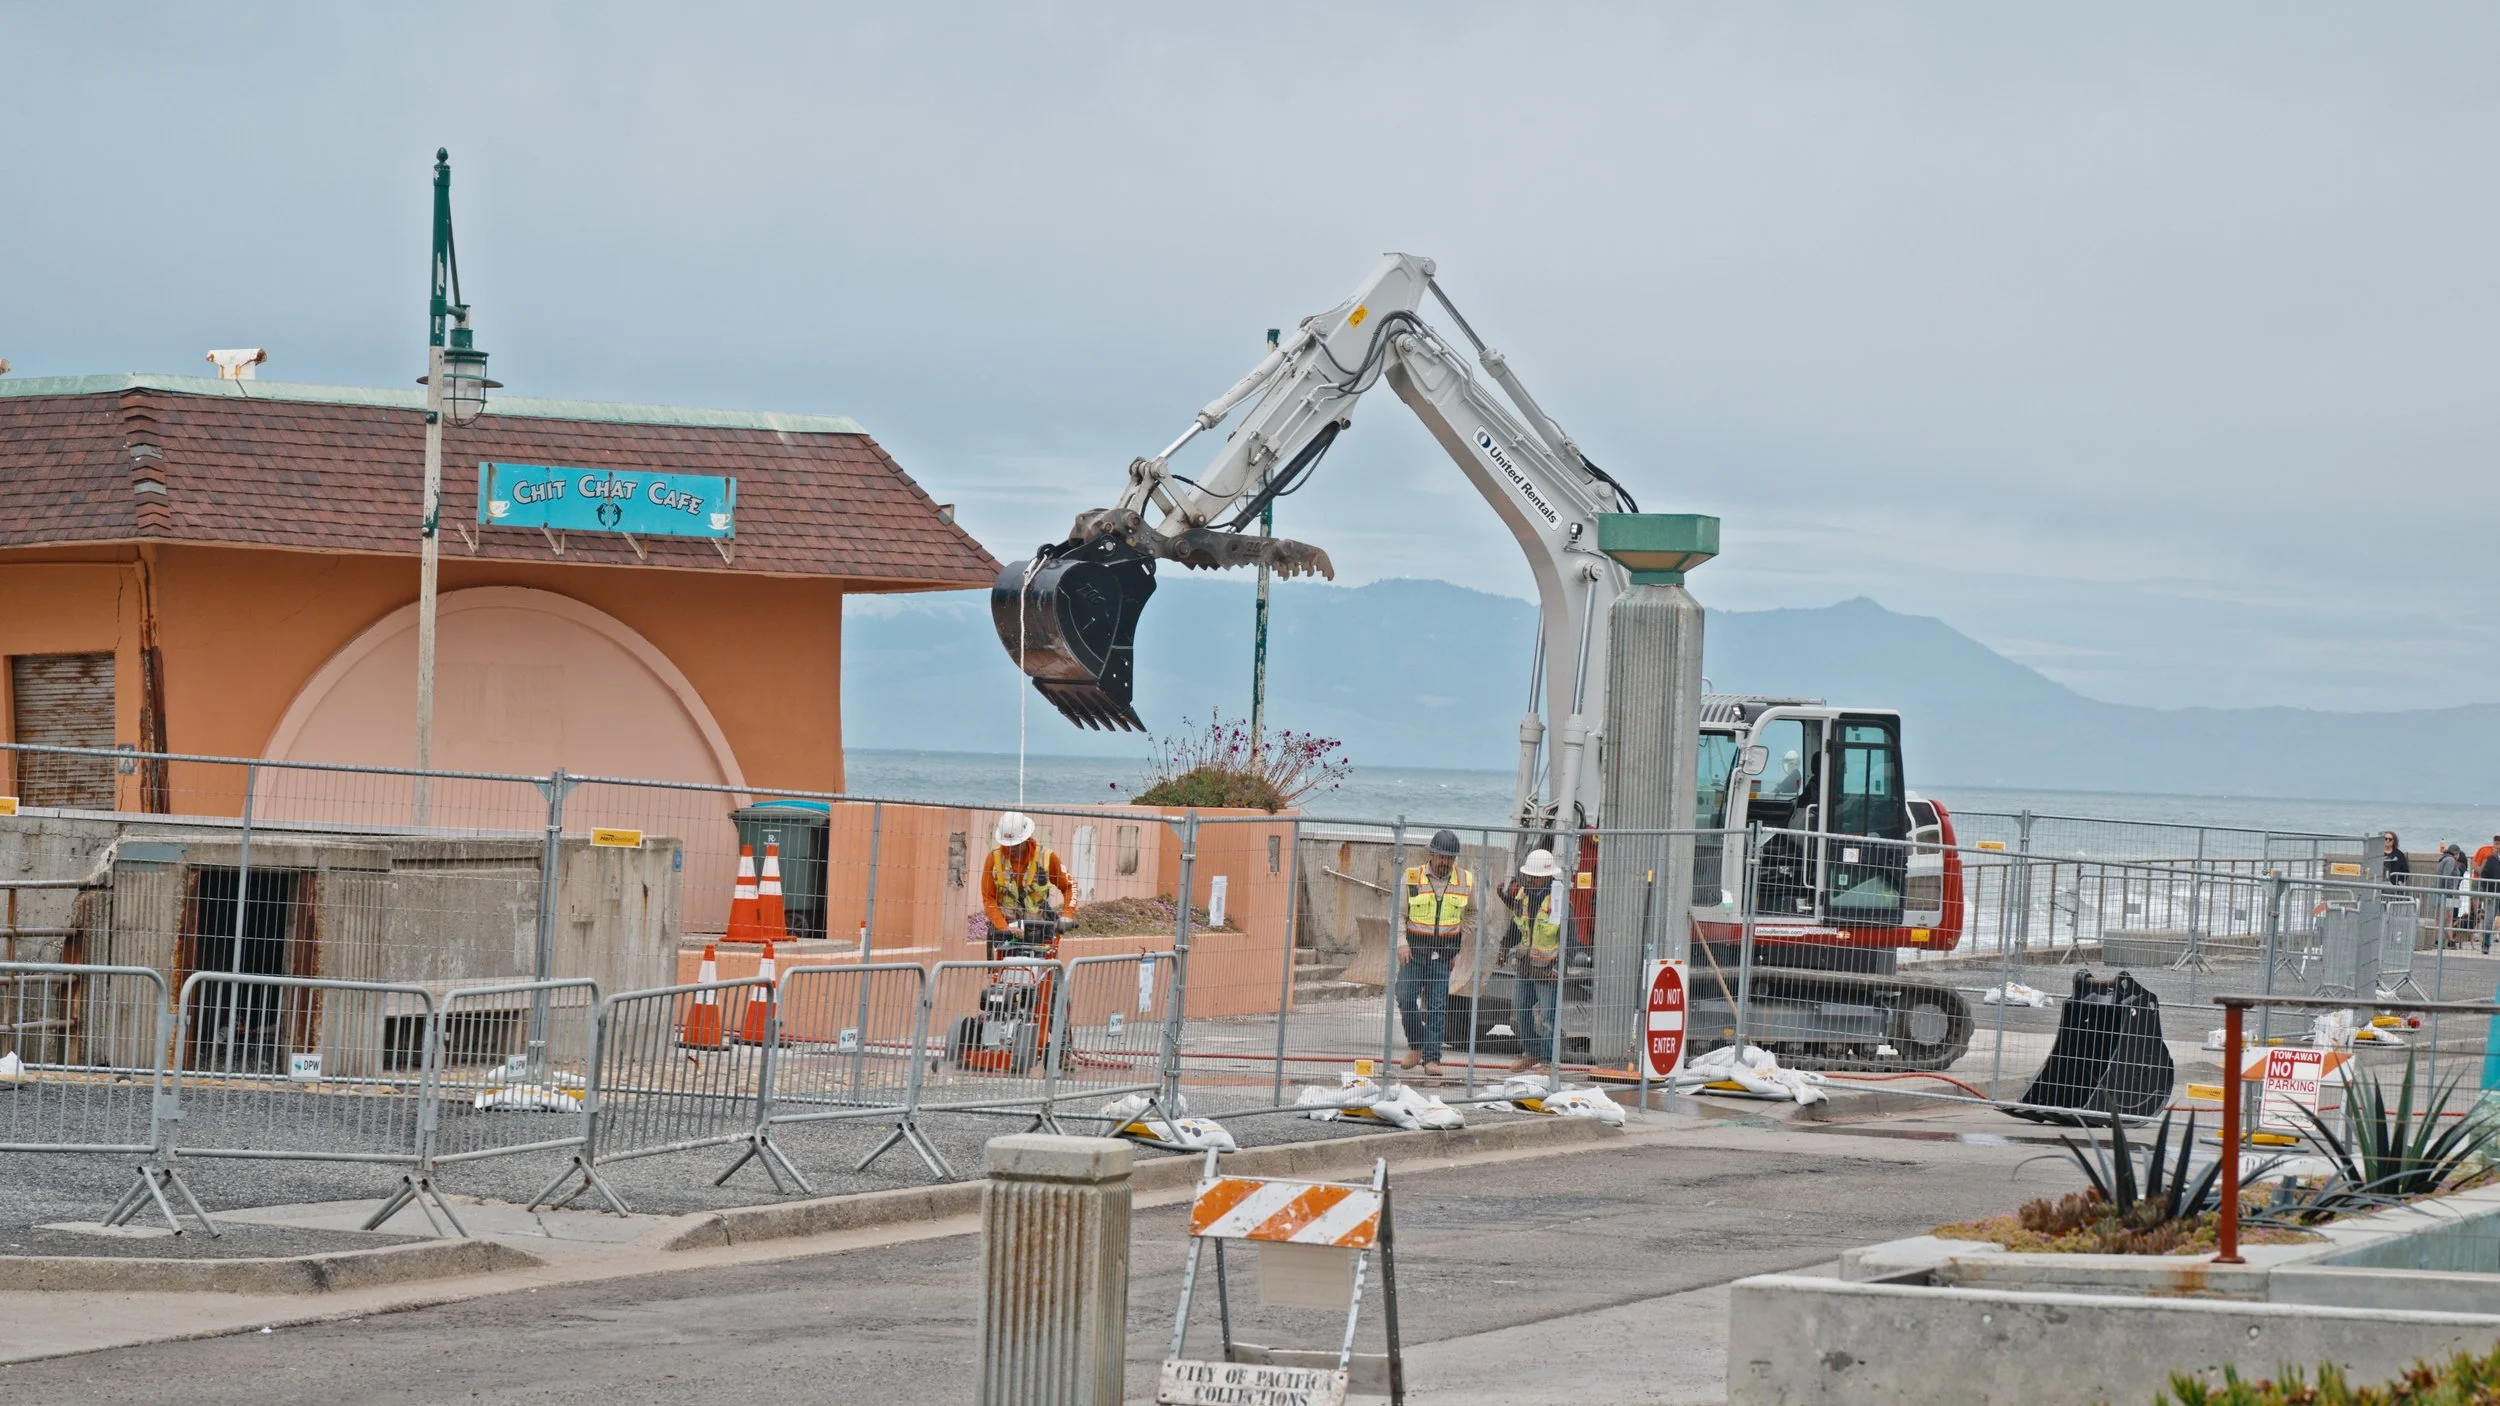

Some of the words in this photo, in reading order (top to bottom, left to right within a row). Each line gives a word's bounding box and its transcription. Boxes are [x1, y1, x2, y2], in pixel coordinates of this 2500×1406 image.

[1489, 446, 1524, 485] United
[1520, 482, 1558, 525] Rentals
[1653, 988, 1663, 1005] DO
[1666, 988, 1681, 1005] NOT
[1653, 1037, 1676, 1054] ENTER
[2273, 1050, 2320, 1062] TOW-AWAY
[304, 1060, 320, 1070] DPW
[2270, 1061, 2292, 1077] NO
[2267, 1079, 2316, 1092] PARKING
[1176, 1364, 1217, 1383] CITY
[1225, 1368, 1248, 1385] OF
[1256, 1371, 1333, 1392] PACIFICA
[1193, 1386, 1309, 1406] COLLECTIONS
